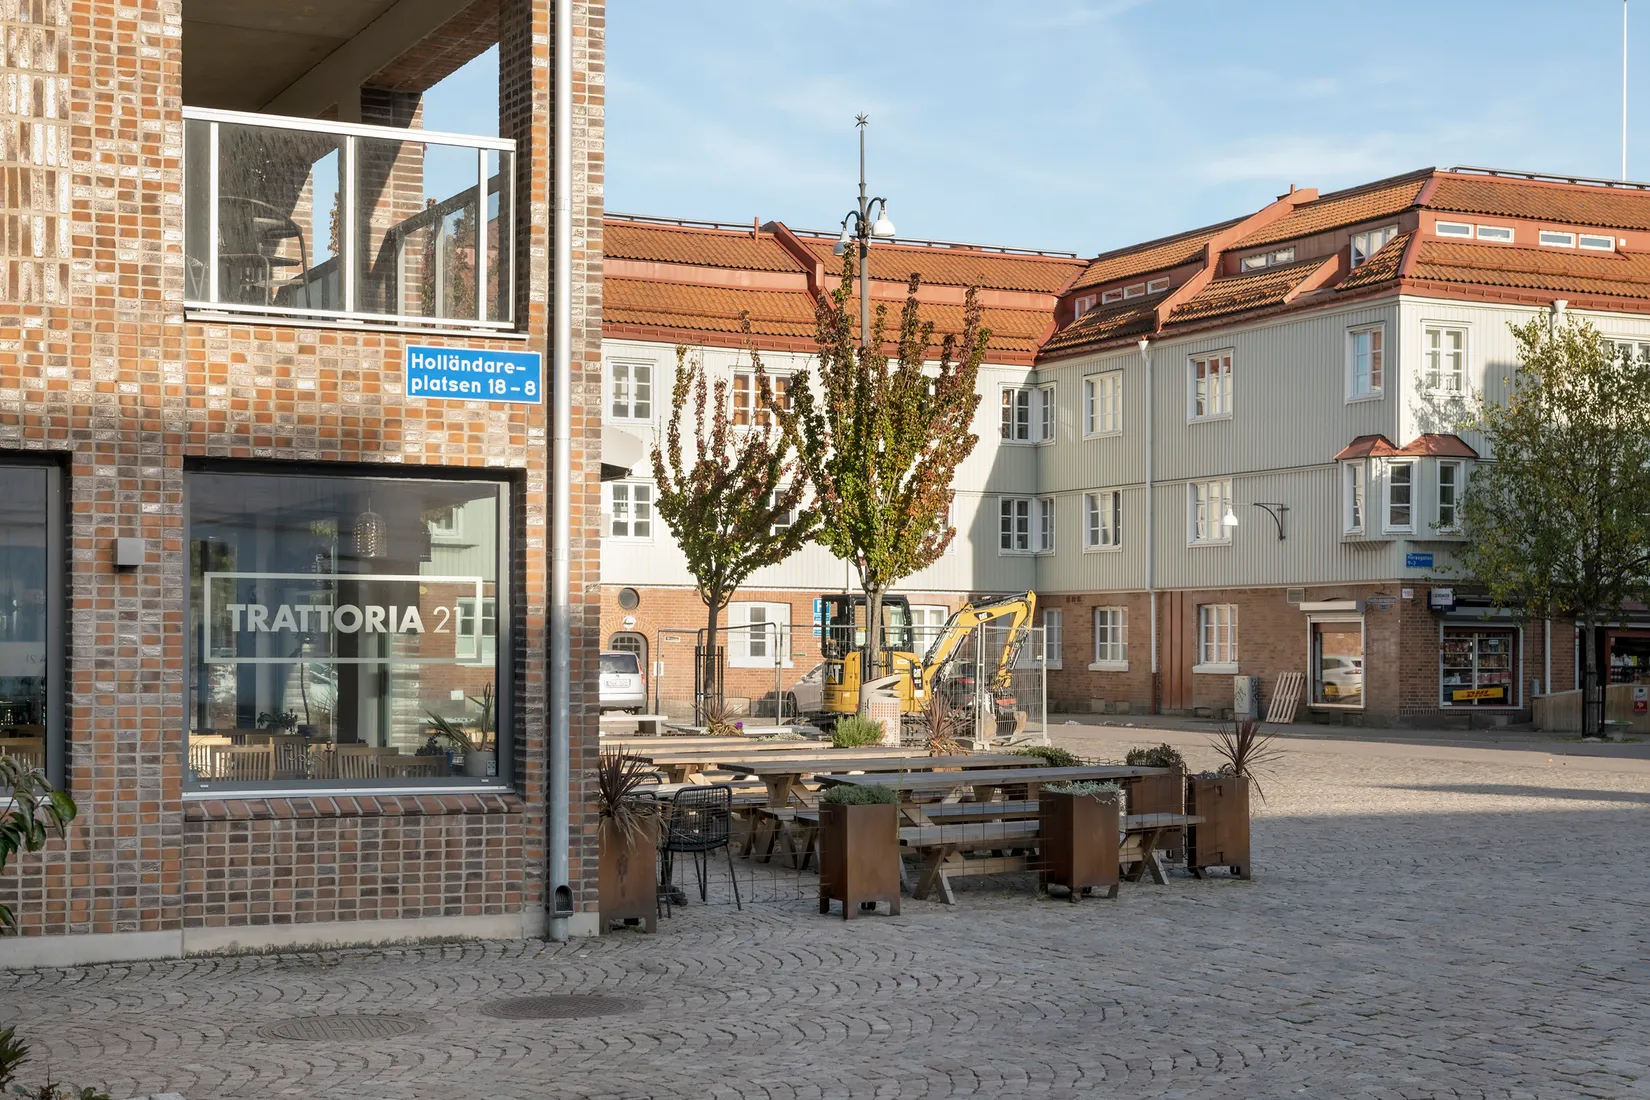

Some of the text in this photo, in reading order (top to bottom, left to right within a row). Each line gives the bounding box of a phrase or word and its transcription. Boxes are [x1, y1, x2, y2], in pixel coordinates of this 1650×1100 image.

[411, 353, 526, 374] Holländare-
[411, 375, 481, 393] platsen
[226, 604, 461, 633] TRATTORIA 21
[1466, 689, 1489, 698] DHL
